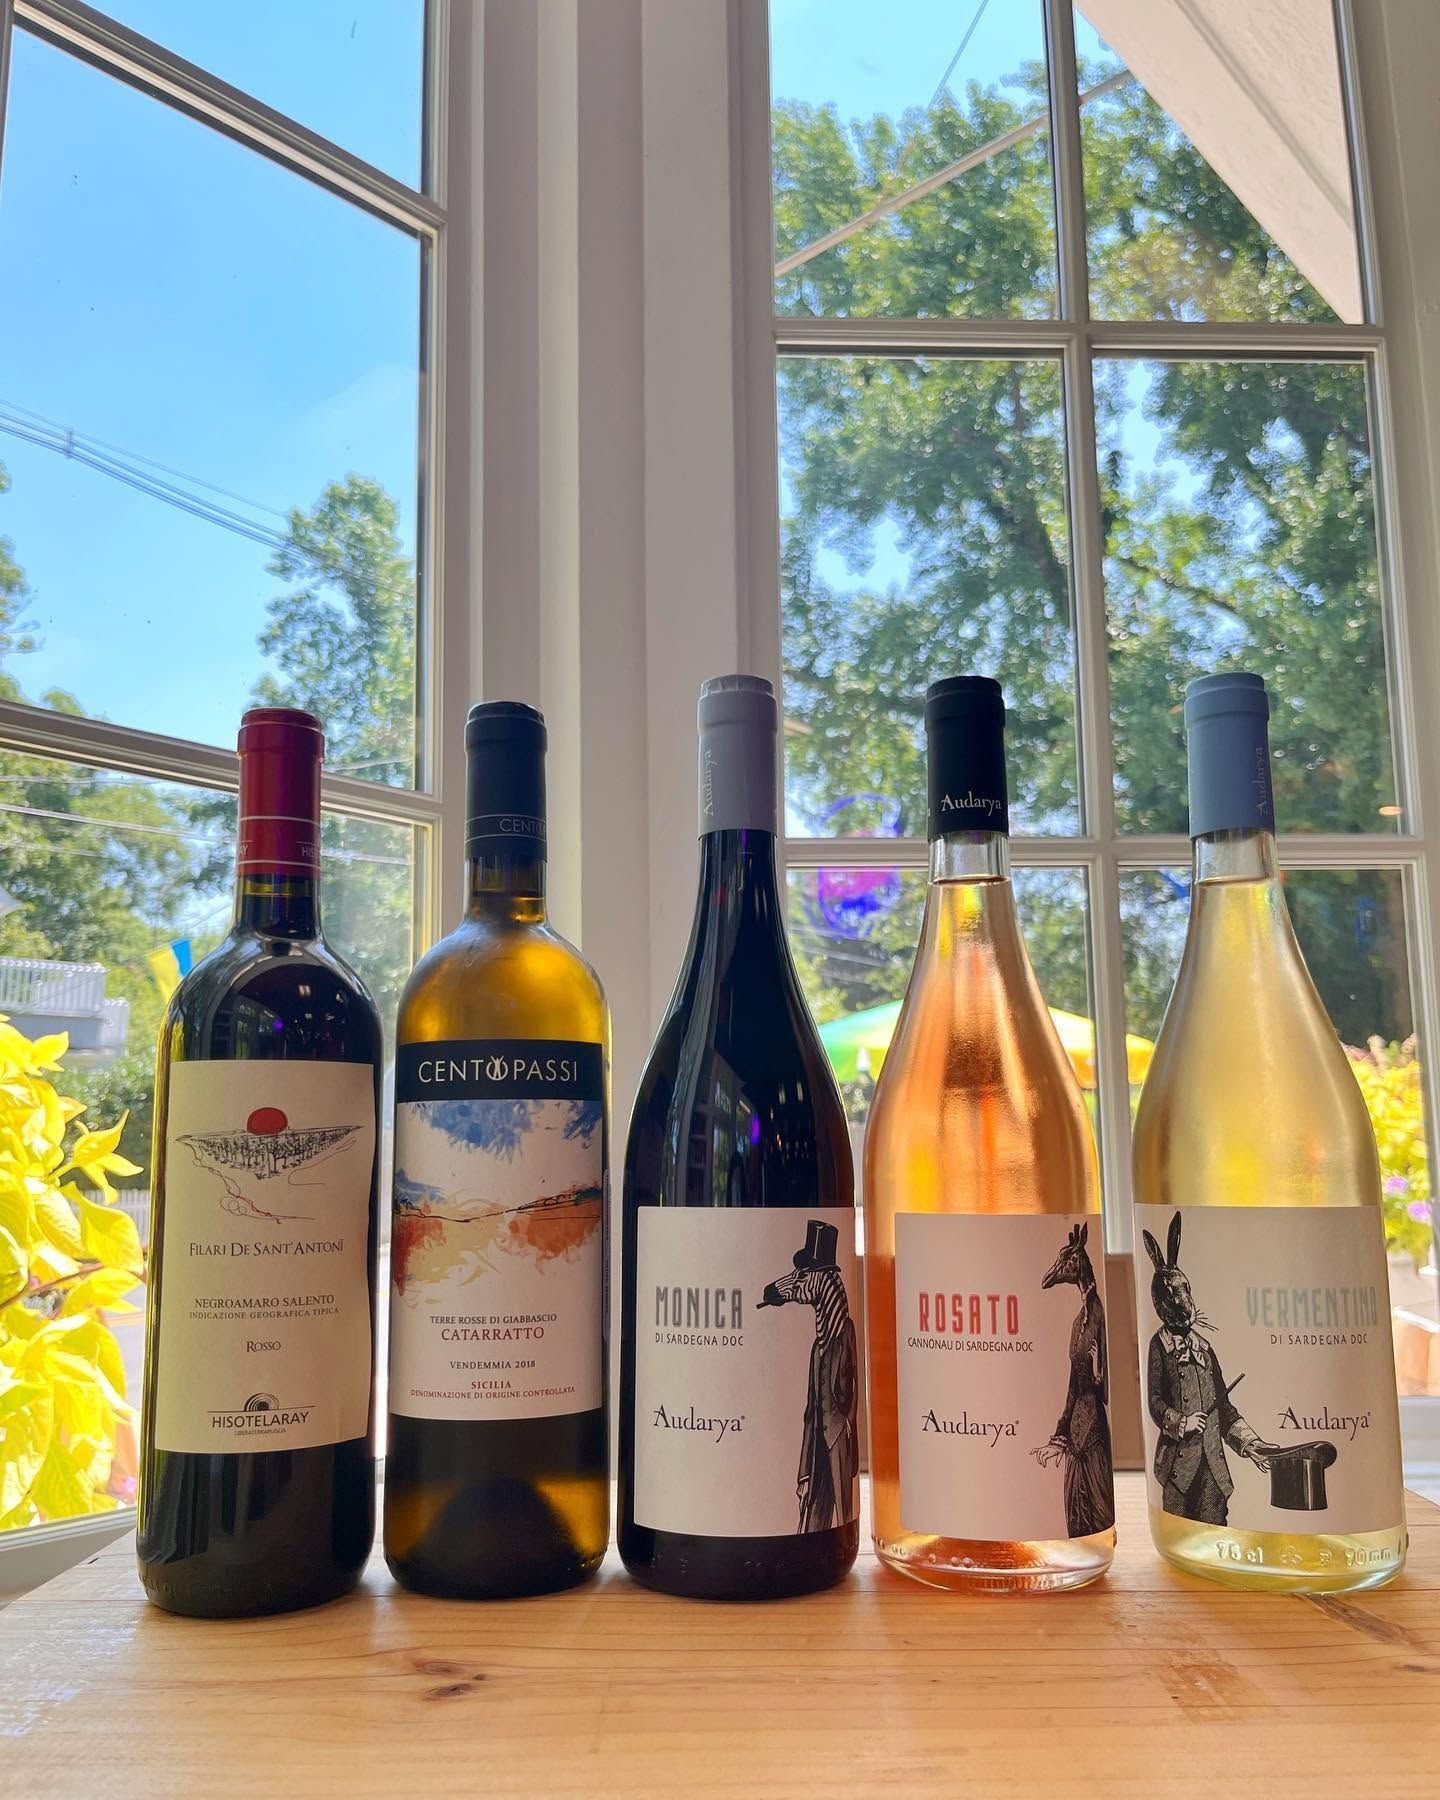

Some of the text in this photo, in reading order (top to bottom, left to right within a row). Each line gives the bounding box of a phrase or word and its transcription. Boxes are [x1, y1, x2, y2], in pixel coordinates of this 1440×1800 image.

[941, 791, 1002, 816] Audarya
[418, 1056, 578, 1083] CENTOPASSI
[190, 1242, 226, 1256] FILARI
[231, 1242, 250, 1257] DE
[195, 1294, 335, 1309] NEGROAMARO SALENTO
[655, 1286, 743, 1329] MONICA
[1245, 1286, 1378, 1329] VERMENTINO
[190, 1307, 340, 1319] INDICAZIONE GEOGRAFICA TIPICA
[429, 1313, 557, 1324] TERRE ROSSE DI GIABBASCIO
[919, 1292, 1019, 1335] ROSATO
[441, 1327, 545, 1341] CATARRATTO
[655, 1332, 744, 1347] DI SARDEGNA DOC
[1270, 1333, 1368, 1345] DI SARDEGNA DOC
[246, 1341, 281, 1352] ROSSO
[908, 1337, 1033, 1352] CANNONAU DI SARDEGNA DOC
[450, 1360, 536, 1370] VENDEMMIA 2018
[410, 1389, 471, 1399] DENOMINAZIONE
[485, 1391, 521, 1399] ORIGINE
[522, 1386, 576, 1397] CONTROLLATA
[471, 1381, 512, 1389] SICILIA
[212, 1411, 310, 1428] HISOTELARAY
